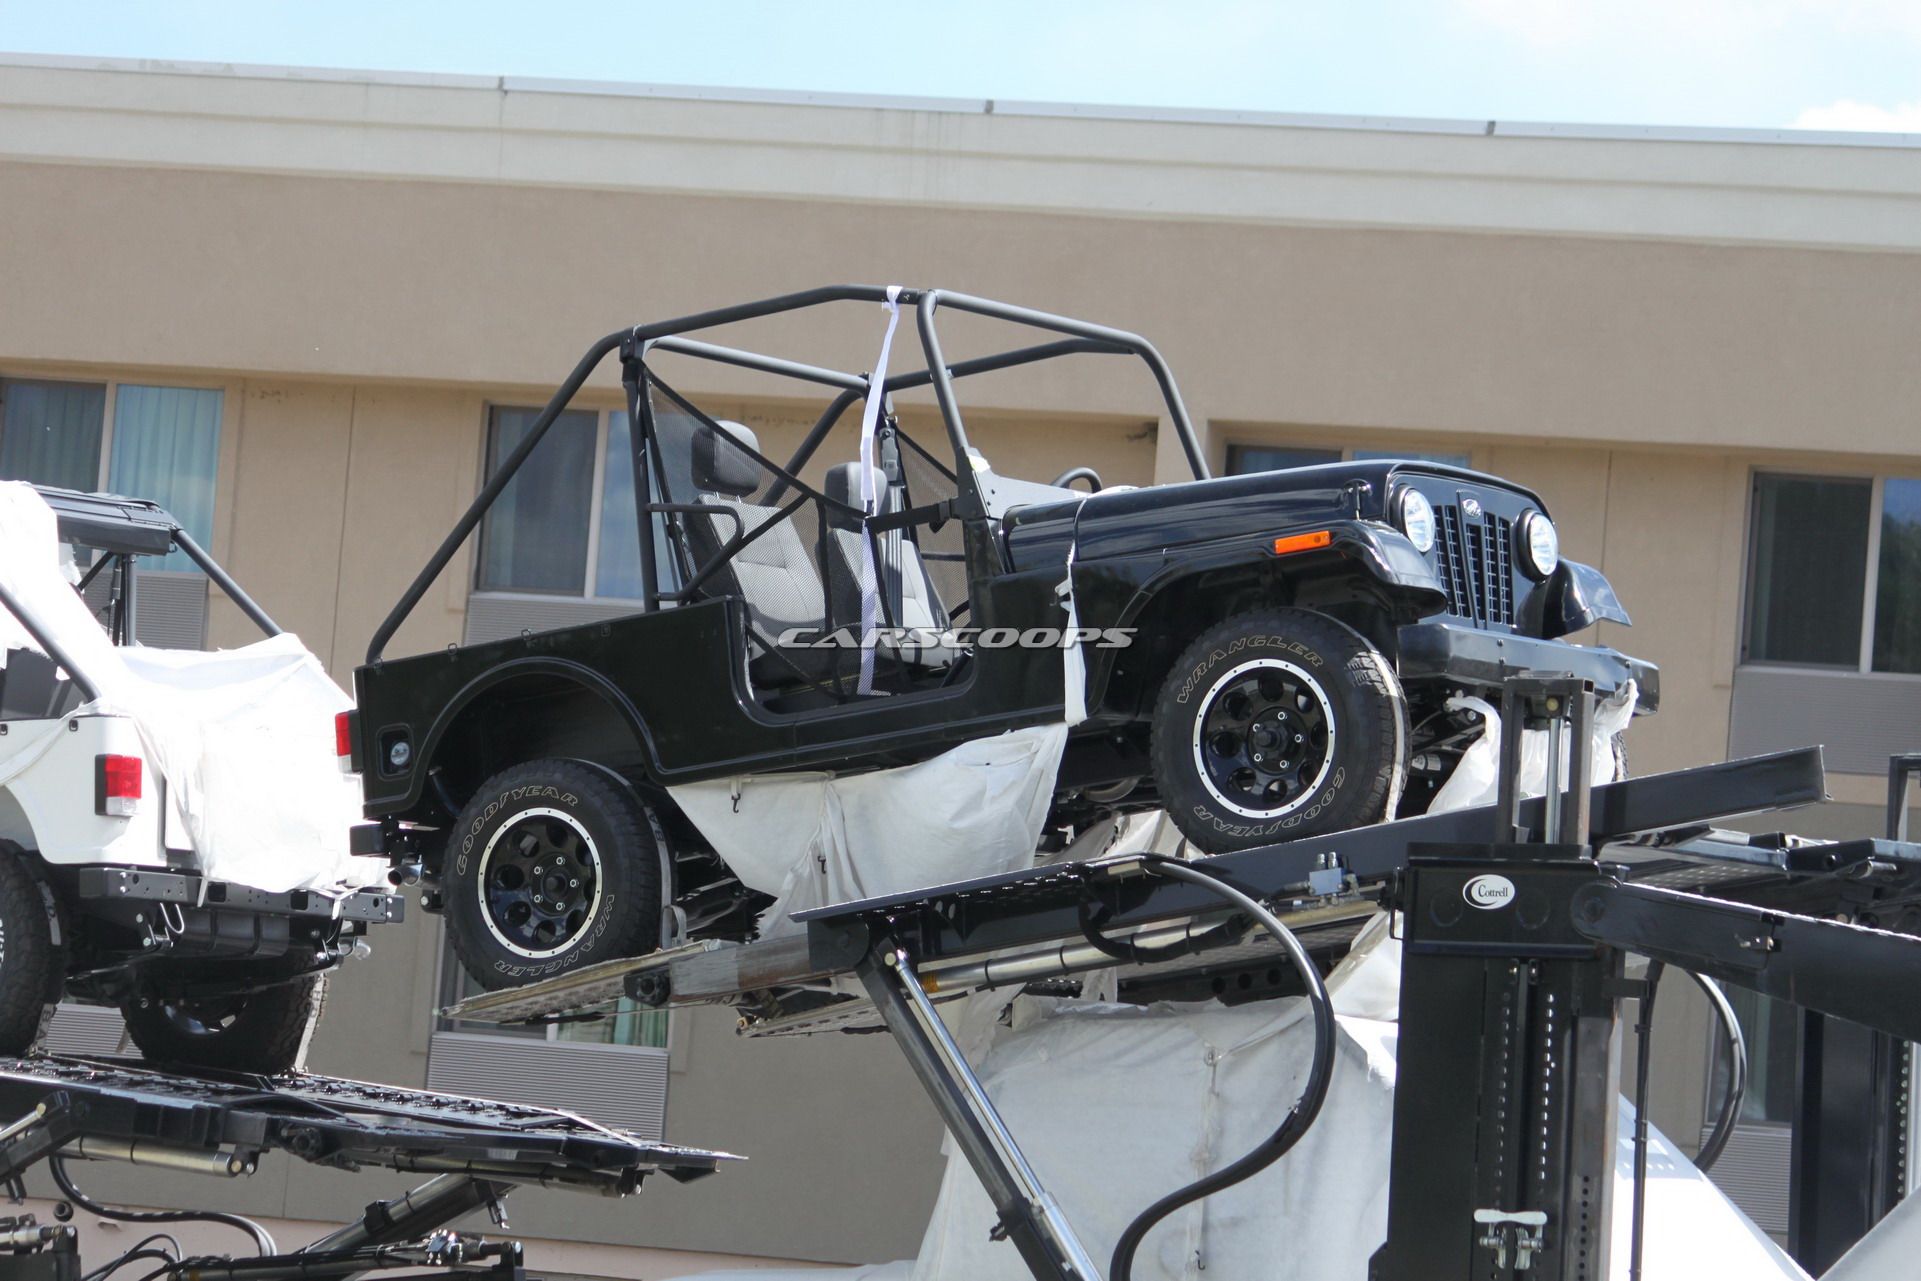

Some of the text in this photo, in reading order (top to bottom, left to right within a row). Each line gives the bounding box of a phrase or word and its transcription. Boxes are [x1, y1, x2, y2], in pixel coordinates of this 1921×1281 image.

[1177, 635, 1323, 703] WRANGLER
[457, 786, 578, 875] GOODYEAR
[1194, 767, 1345, 836] GOODYEAR
[1478, 884, 1508, 898] Cottrell
[494, 895, 615, 977] WRANGLER
